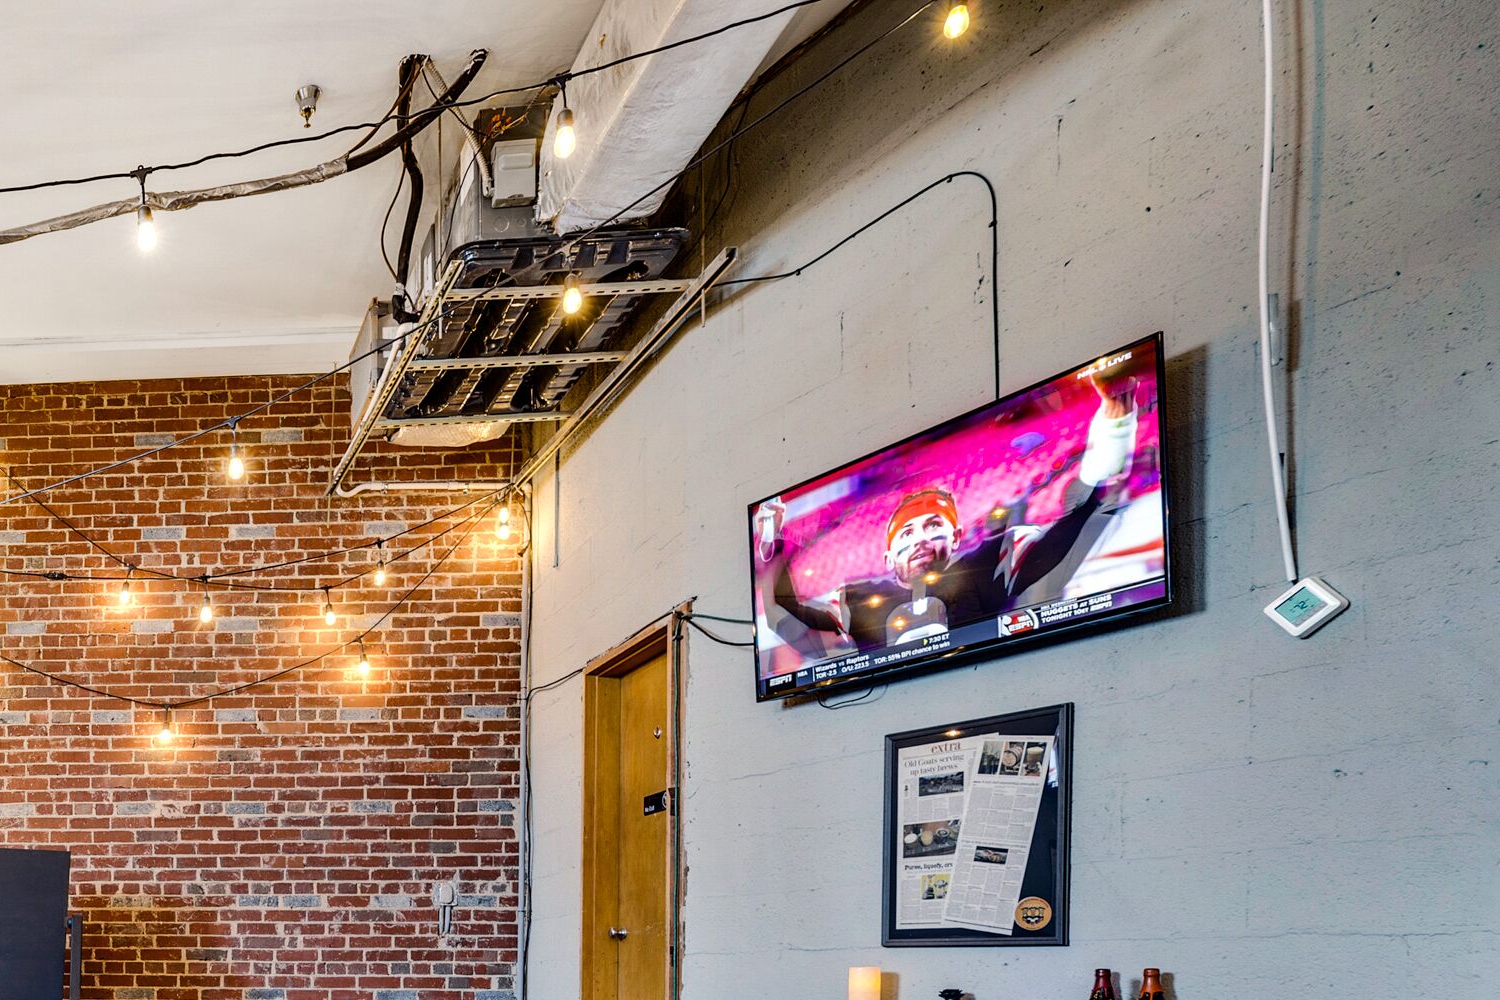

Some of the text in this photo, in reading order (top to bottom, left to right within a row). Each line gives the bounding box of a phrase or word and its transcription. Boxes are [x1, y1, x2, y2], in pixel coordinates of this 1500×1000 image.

[1107, 351, 1133, 367] LIVE
[1041, 602, 1079, 618] NUGGETS
[1088, 594, 1112, 606] SUNS
[1041, 610, 1073, 624] TONIGHT
[1090, 600, 1113, 612] ESPN
[1008, 620, 1034, 632] ESPN
[815, 662, 837, 673] Wizards
[846, 654, 869, 665] Raptors
[816, 672, 827, 680] TOR
[912, 645, 932, 656] chance
[939, 640, 950, 649] win
[769, 673, 792, 687] ESPN
[931, 741, 962, 754] extra
[904, 754, 964, 768] Old Goats serving
[920, 765, 936, 775] tasty
[937, 763, 958, 772] brews
